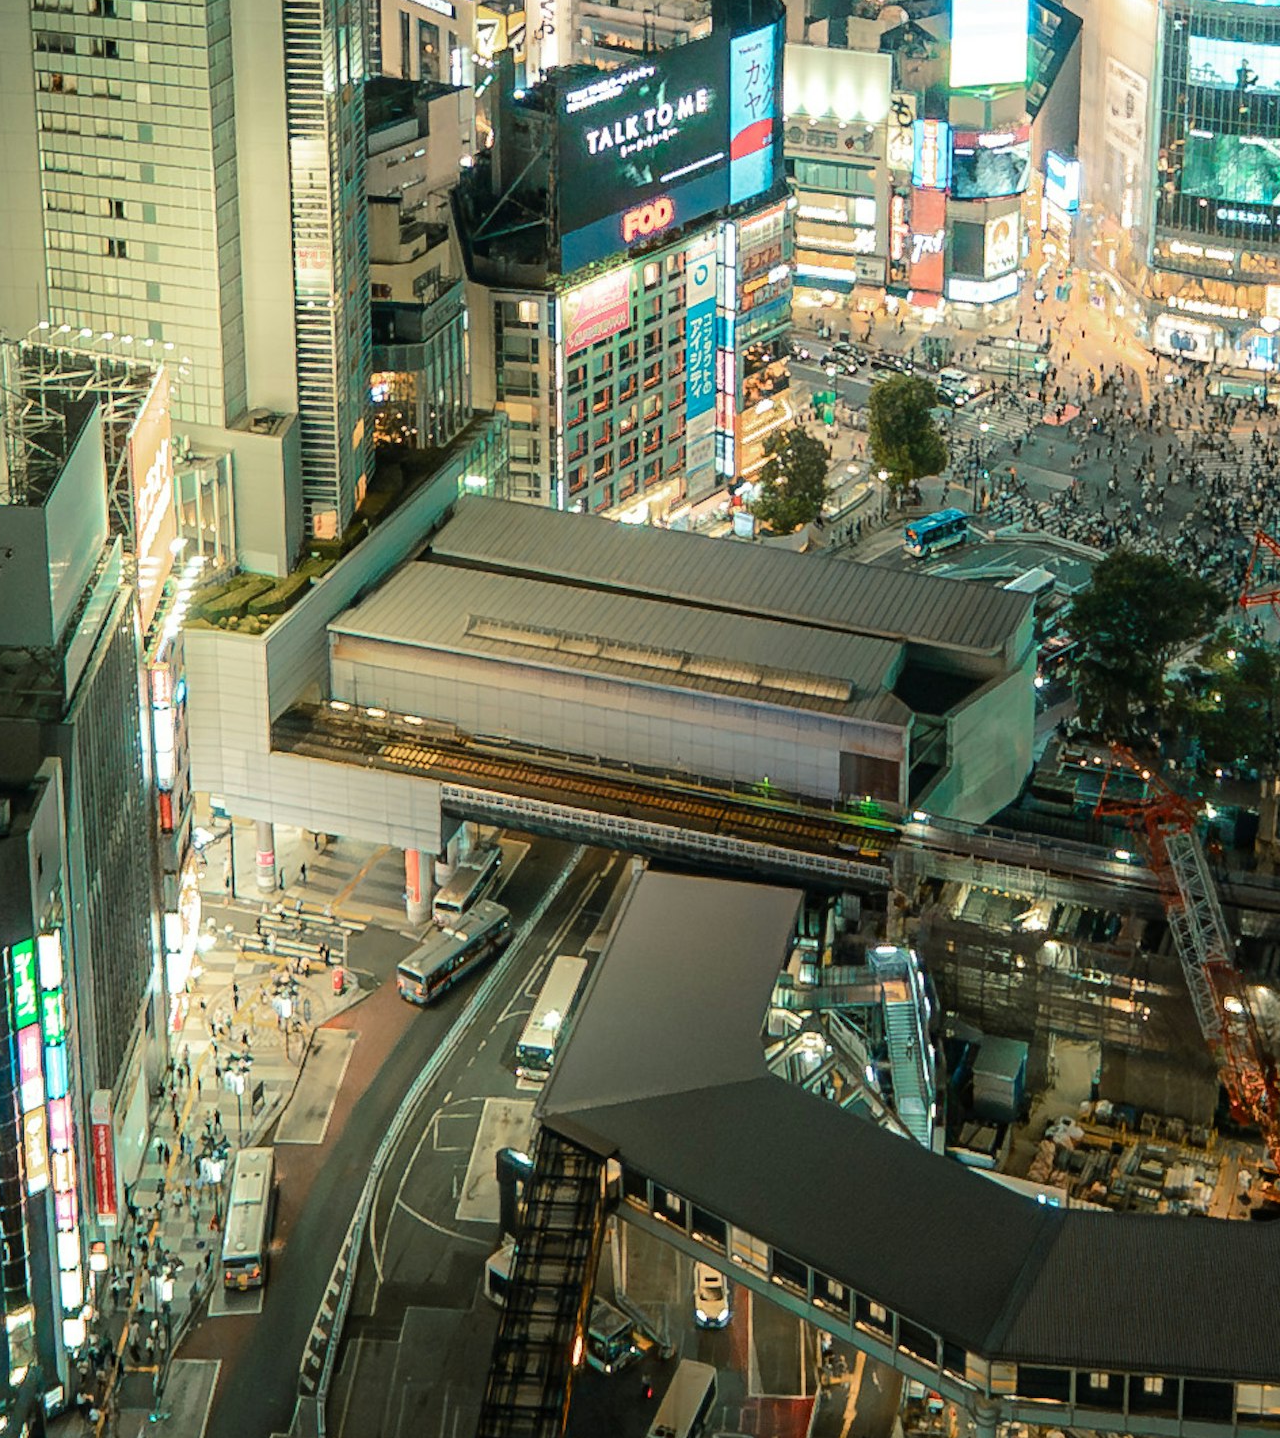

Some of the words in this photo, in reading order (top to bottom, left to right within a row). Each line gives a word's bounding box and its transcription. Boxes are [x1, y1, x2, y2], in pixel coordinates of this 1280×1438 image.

[586, 114, 640, 155] TALK
[643, 103, 674, 132] TO
[677, 88, 708, 121] ME
[623, 196, 674, 243] FOD
